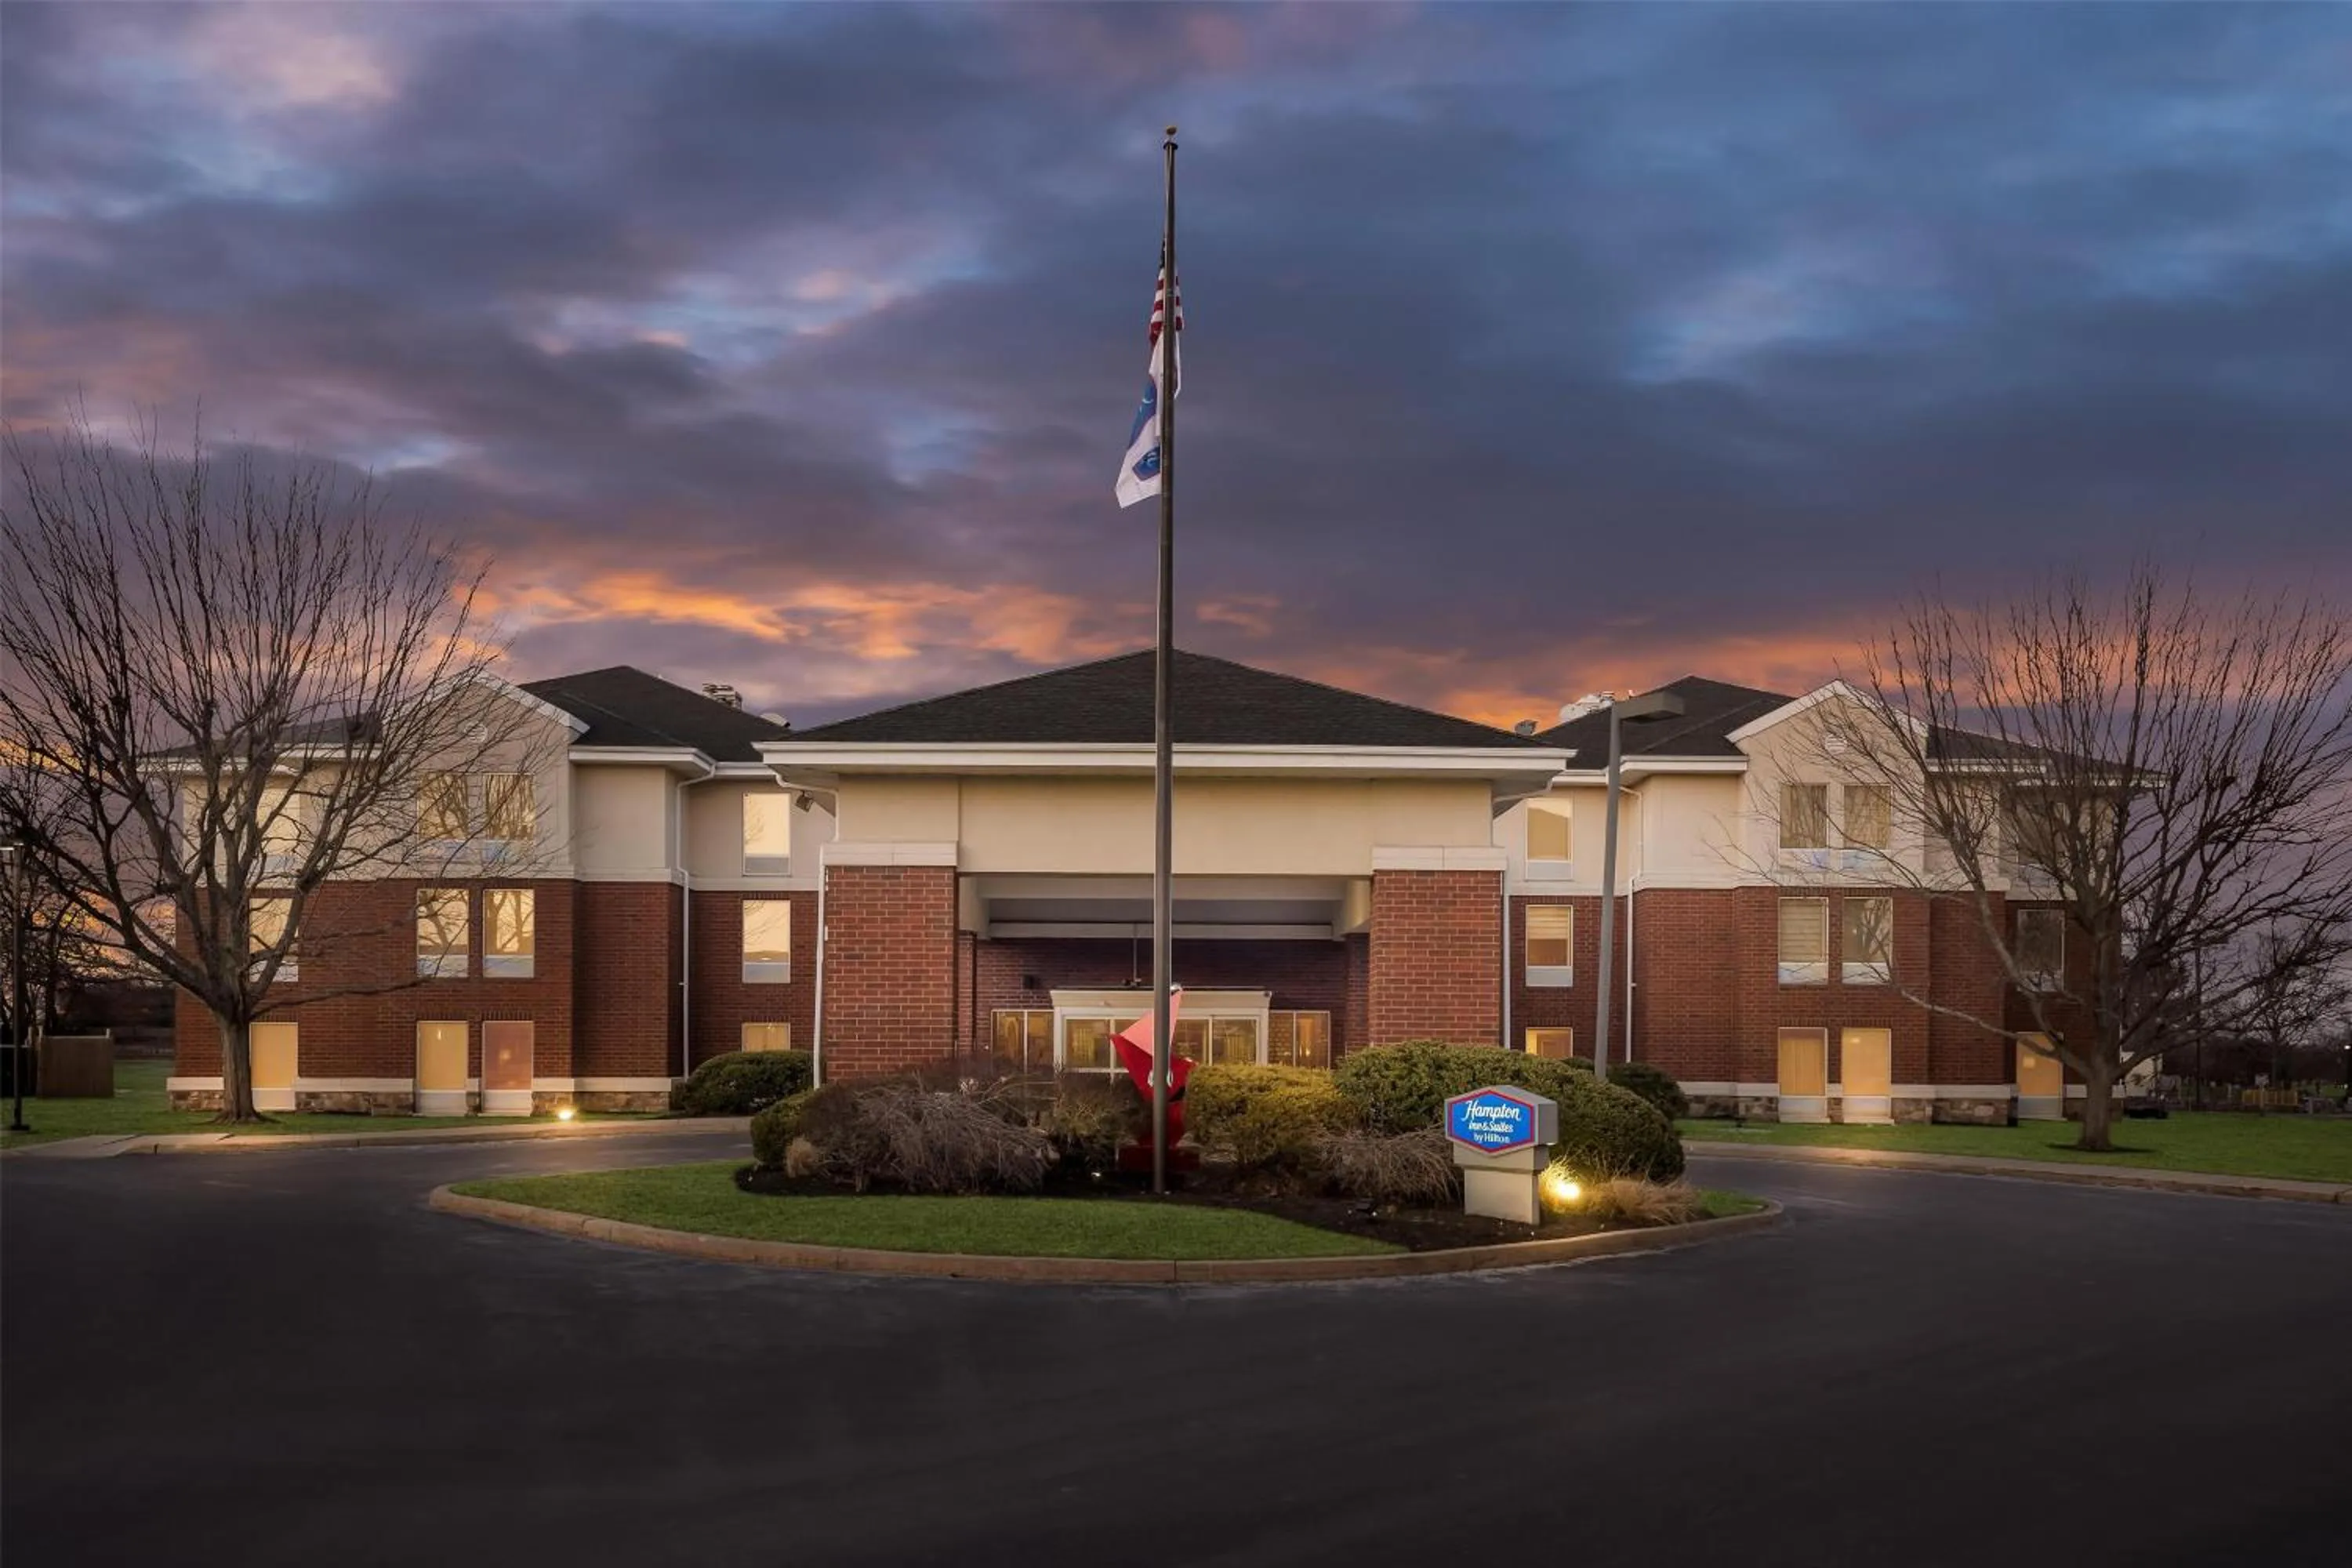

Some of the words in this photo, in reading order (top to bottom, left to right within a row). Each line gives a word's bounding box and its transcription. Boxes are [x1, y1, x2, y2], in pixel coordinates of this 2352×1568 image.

[1461, 1099, 1521, 1121] Hampton
[1474, 1132, 1483, 1143] by
[1484, 1133, 1510, 1143] Hilton
